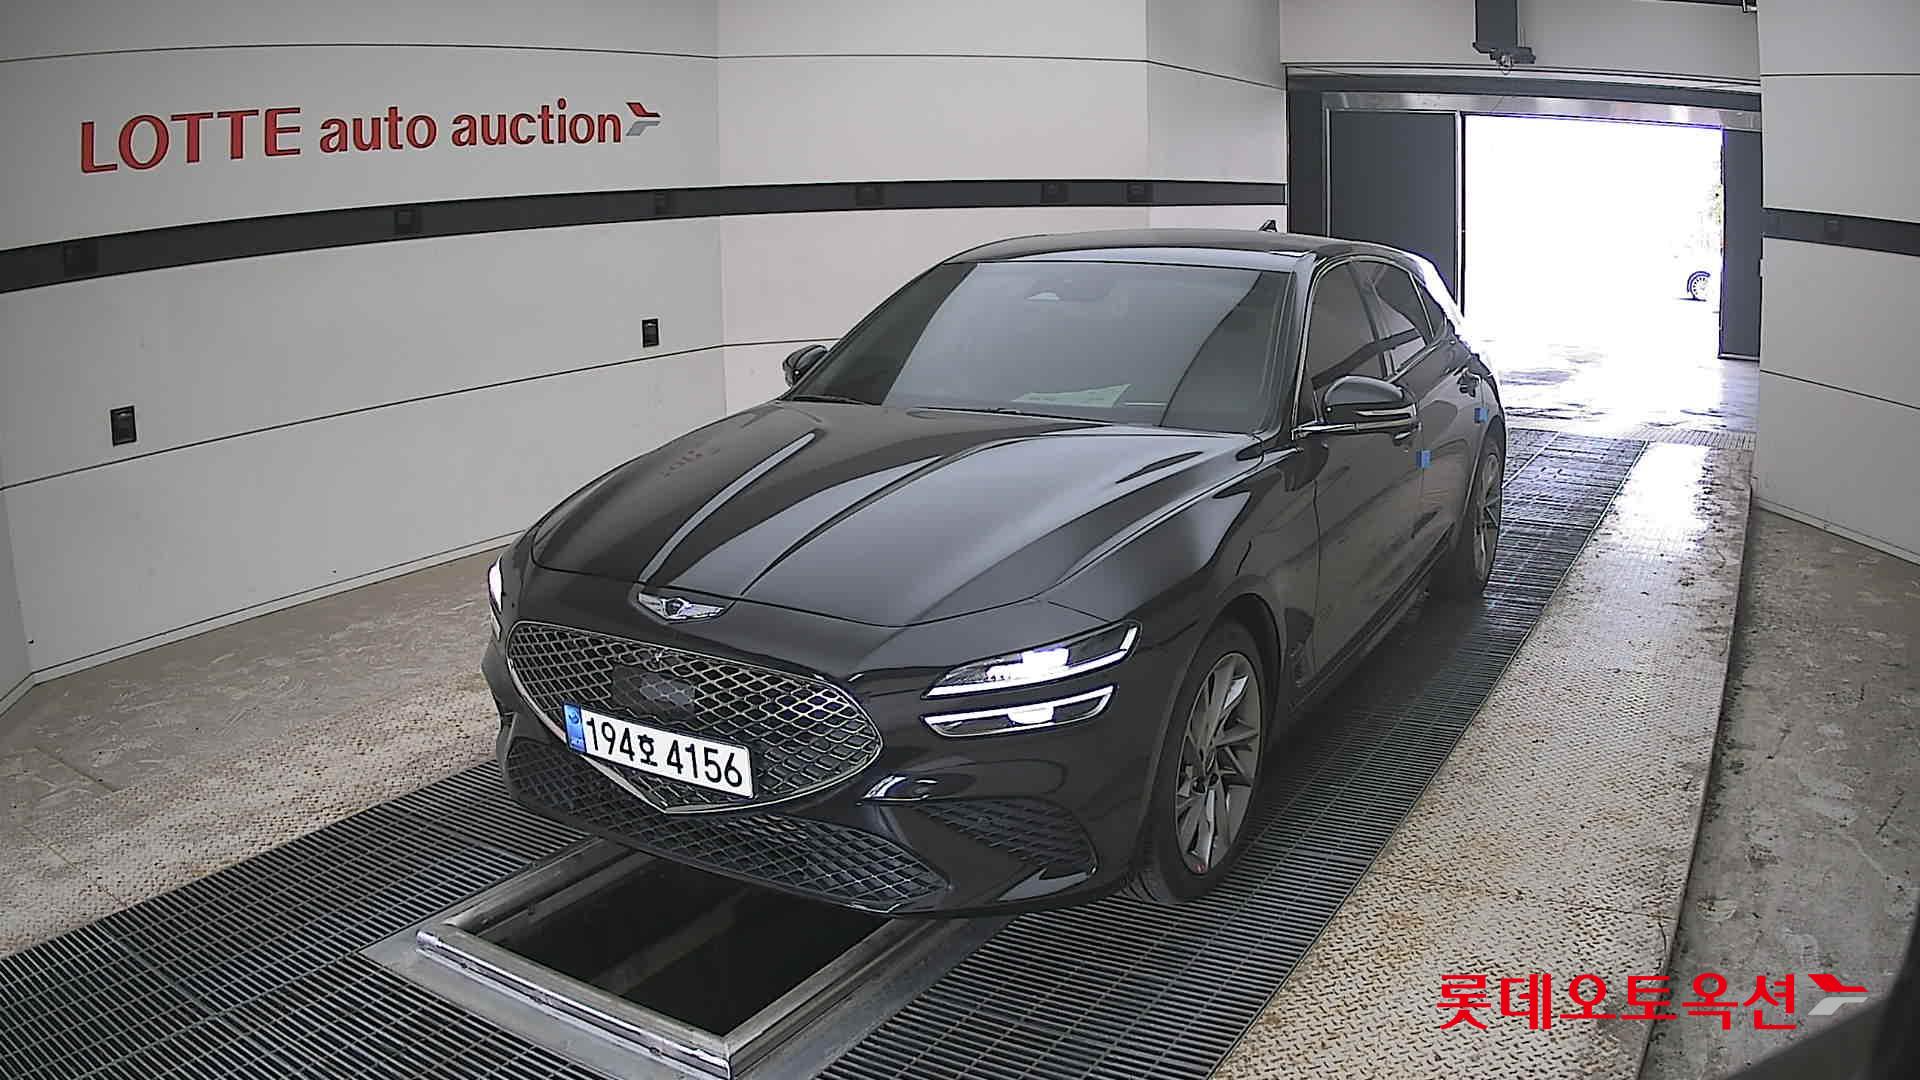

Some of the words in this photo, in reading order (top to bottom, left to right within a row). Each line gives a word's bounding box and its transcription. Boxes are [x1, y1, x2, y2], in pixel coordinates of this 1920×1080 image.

[81, 107, 301, 173] LOTTE
[319, 106, 438, 153] auto
[451, 98, 622, 147] auction
[586, 717, 658, 767] 194호
[666, 739, 743, 787] 4156
